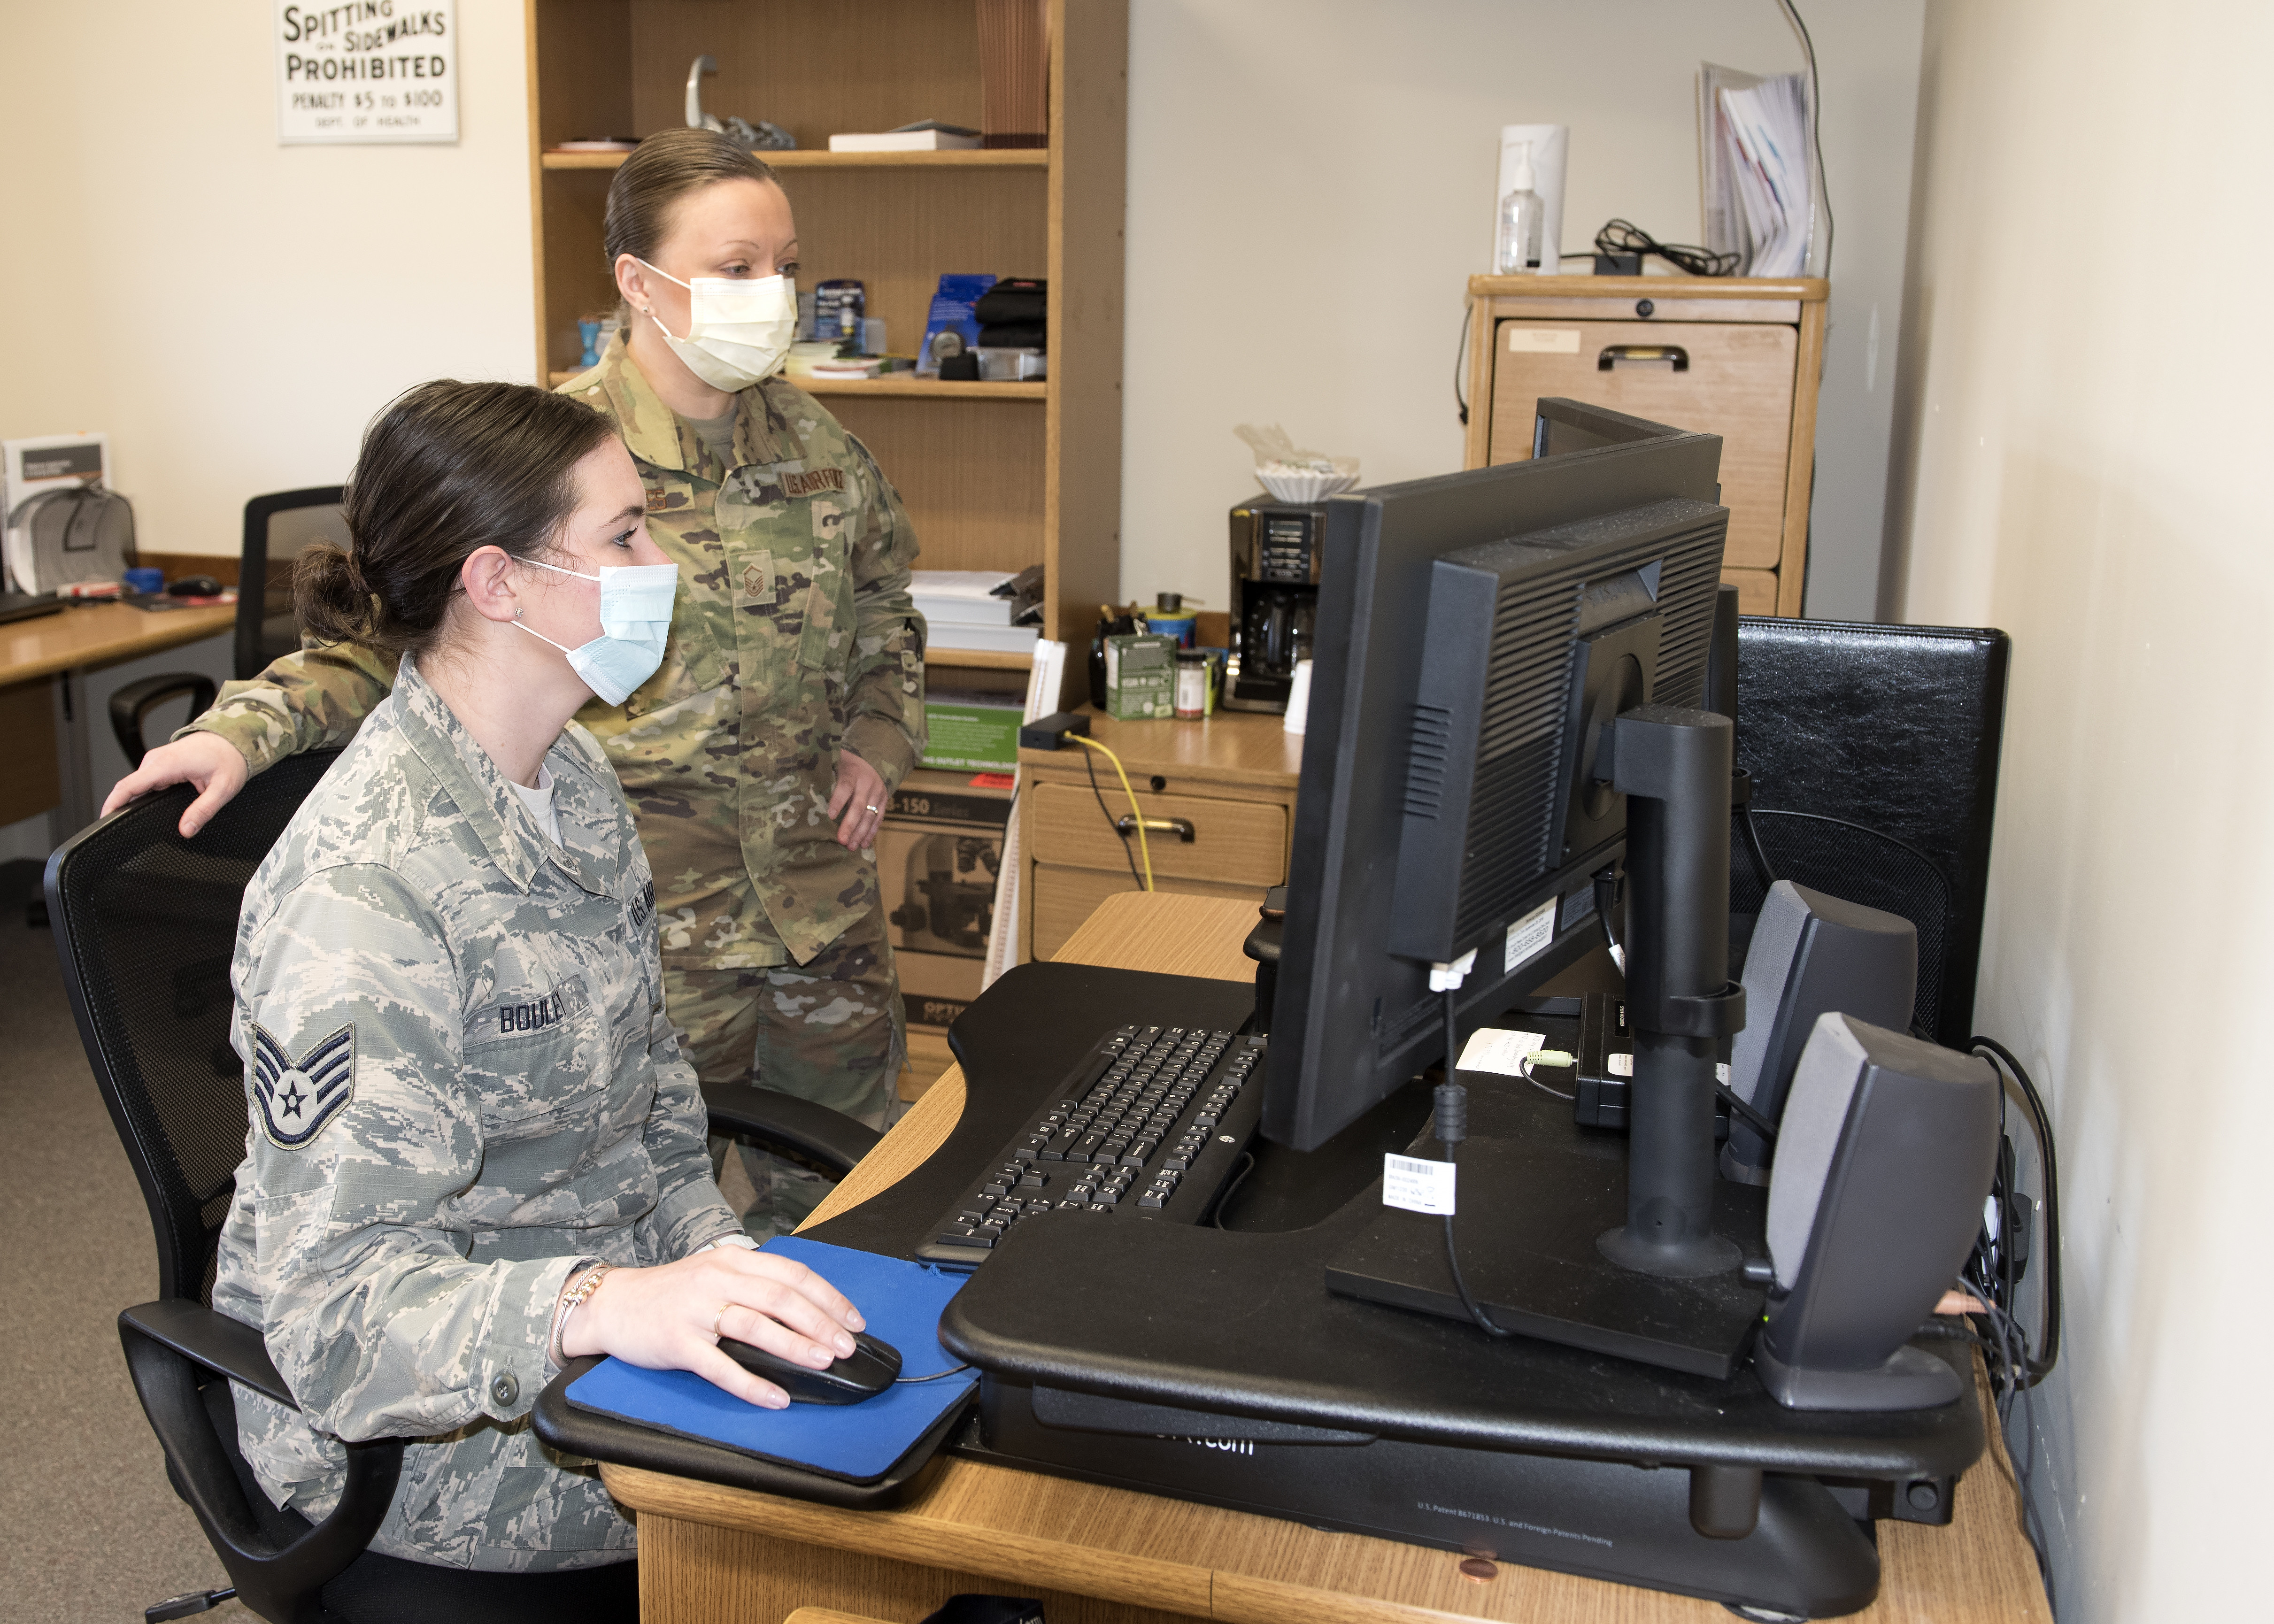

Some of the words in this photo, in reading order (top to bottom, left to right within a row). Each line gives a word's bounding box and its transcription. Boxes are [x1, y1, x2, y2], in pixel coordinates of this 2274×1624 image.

[284, 0, 392, 41] SPITTING
[343, 11, 445, 52] SIDEWALKS
[286, 54, 445, 81] PROHIBITED
[292, 92, 344, 109] PENALTY
[354, 91, 374, 112] $5
[381, 95, 397, 108] TO
[404, 90, 442, 108] $100
[353, 115, 367, 128] OF
[377, 115, 421, 127] HEALTH
[1433, 1504, 1457, 1516] Patent
[1509, 1521, 1523, 1529] and
[1524, 1522, 1552, 1535] Foreign
[1552, 1527, 1581, 1540] Patents
[1581, 1533, 1612, 1548] Pending
